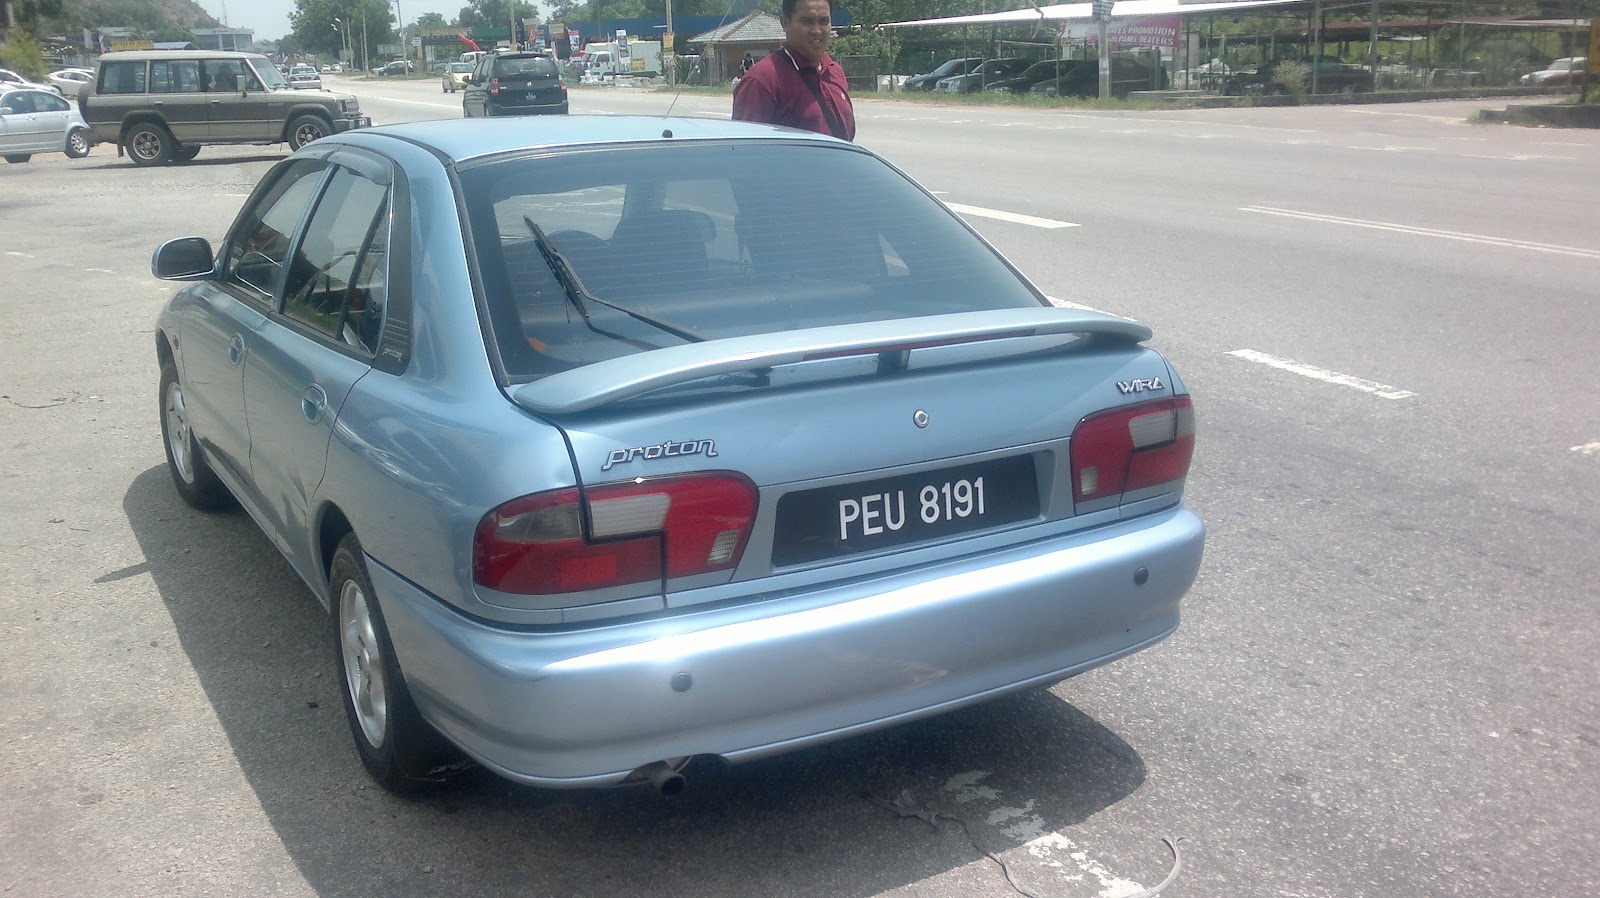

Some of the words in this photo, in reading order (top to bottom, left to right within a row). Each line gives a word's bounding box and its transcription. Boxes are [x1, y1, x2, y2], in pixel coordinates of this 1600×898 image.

[1118, 35, 1137, 43] PANEL
[1139, 36, 1174, 45] DEALERS
[1127, 26, 1176, 36] PROMOTION
[1116, 376, 1166, 395] WIRA
[601, 438, 719, 472] proton
[839, 490, 905, 541] PEU
[919, 476, 985, 524] 8191
